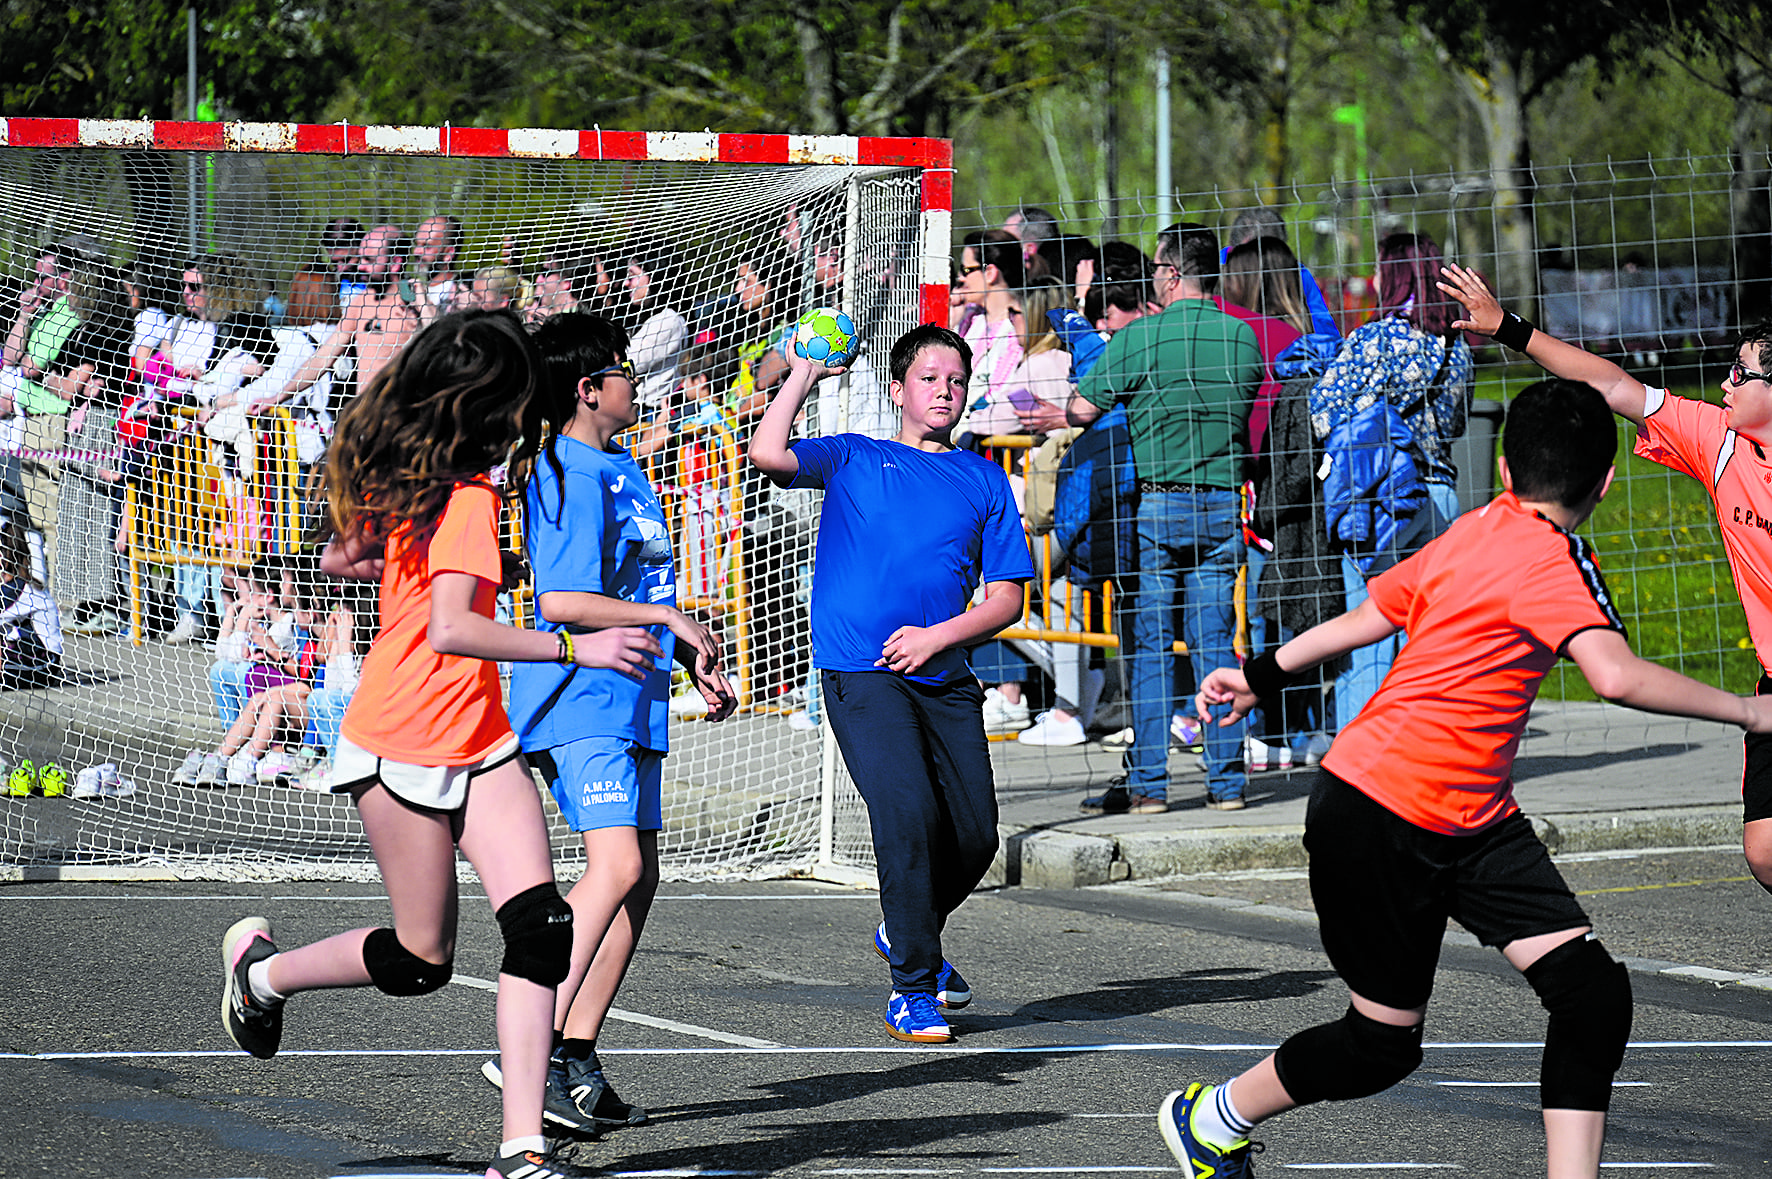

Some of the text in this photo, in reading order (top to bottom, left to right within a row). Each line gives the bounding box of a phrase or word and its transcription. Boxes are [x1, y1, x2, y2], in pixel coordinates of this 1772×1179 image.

[583, 780, 625, 794] A.M.P.A.
[582, 792, 629, 807] LA PALOMERA
